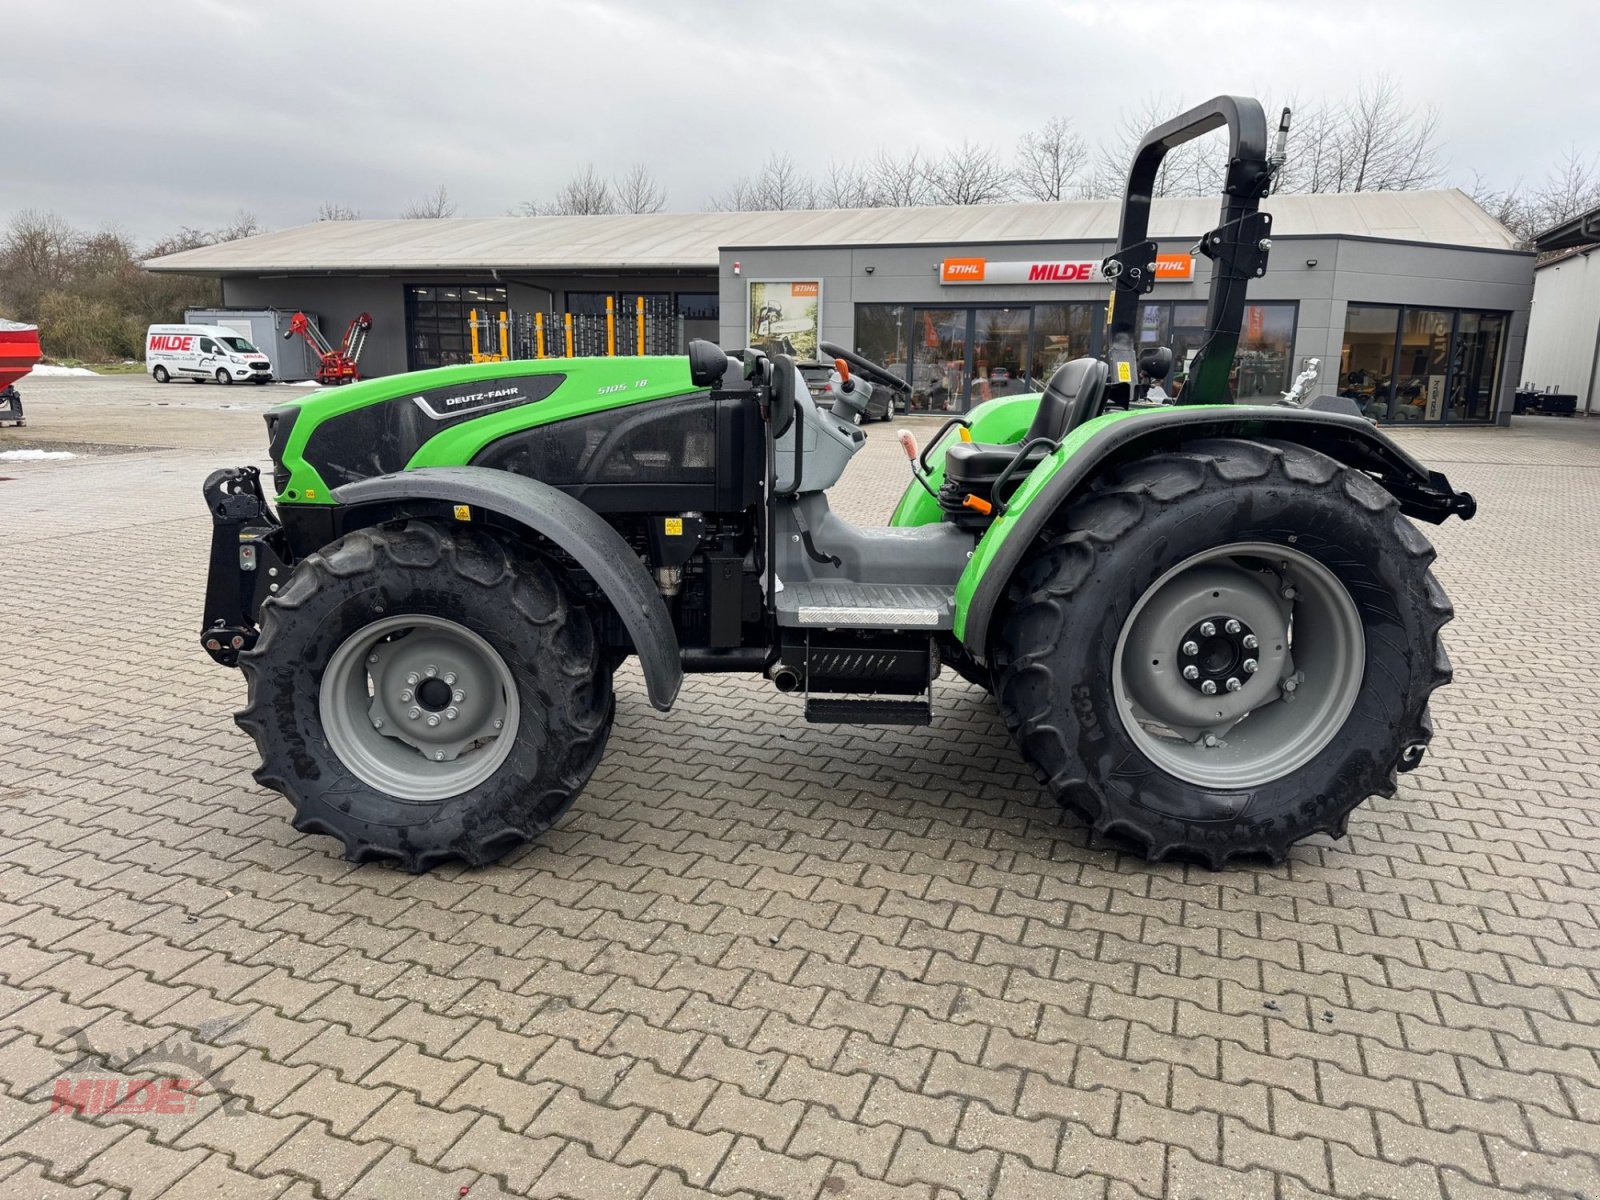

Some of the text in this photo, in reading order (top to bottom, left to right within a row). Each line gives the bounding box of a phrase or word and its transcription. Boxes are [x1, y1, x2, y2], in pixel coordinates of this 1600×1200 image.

[947, 264, 980, 274] STIHL
[1028, 264, 1093, 280] MILDE
[1155, 261, 1185, 271] TIHL
[149, 336, 192, 351] MILDE
[597, 383, 627, 395] 5105
[446, 387, 519, 406] DEUTZ-FAHR
